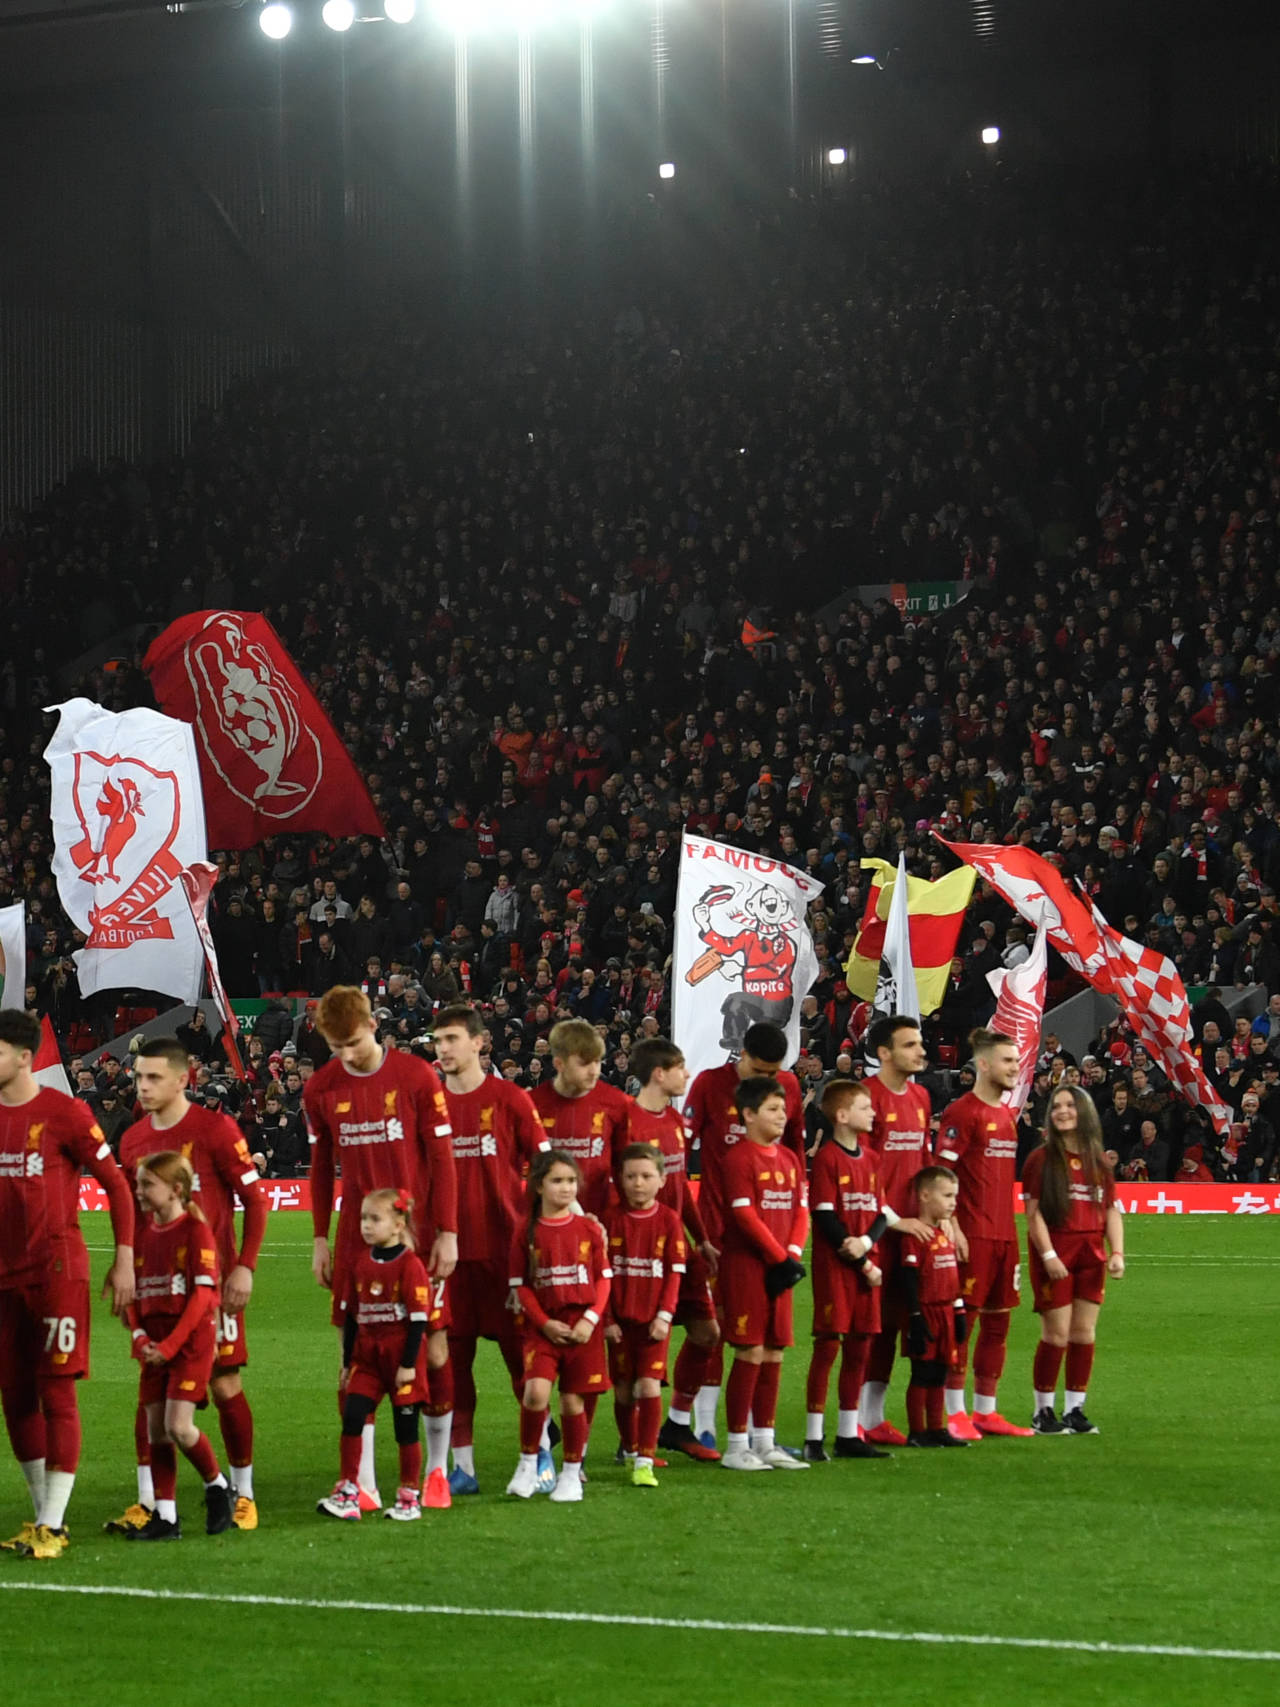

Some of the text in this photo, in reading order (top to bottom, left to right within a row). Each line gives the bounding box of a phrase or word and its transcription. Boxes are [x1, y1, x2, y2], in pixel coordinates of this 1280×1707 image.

[339, 1119, 386, 1135] Standard
[338, 1132, 387, 1147] Chartered
[42, 1316, 78, 1354] 76
